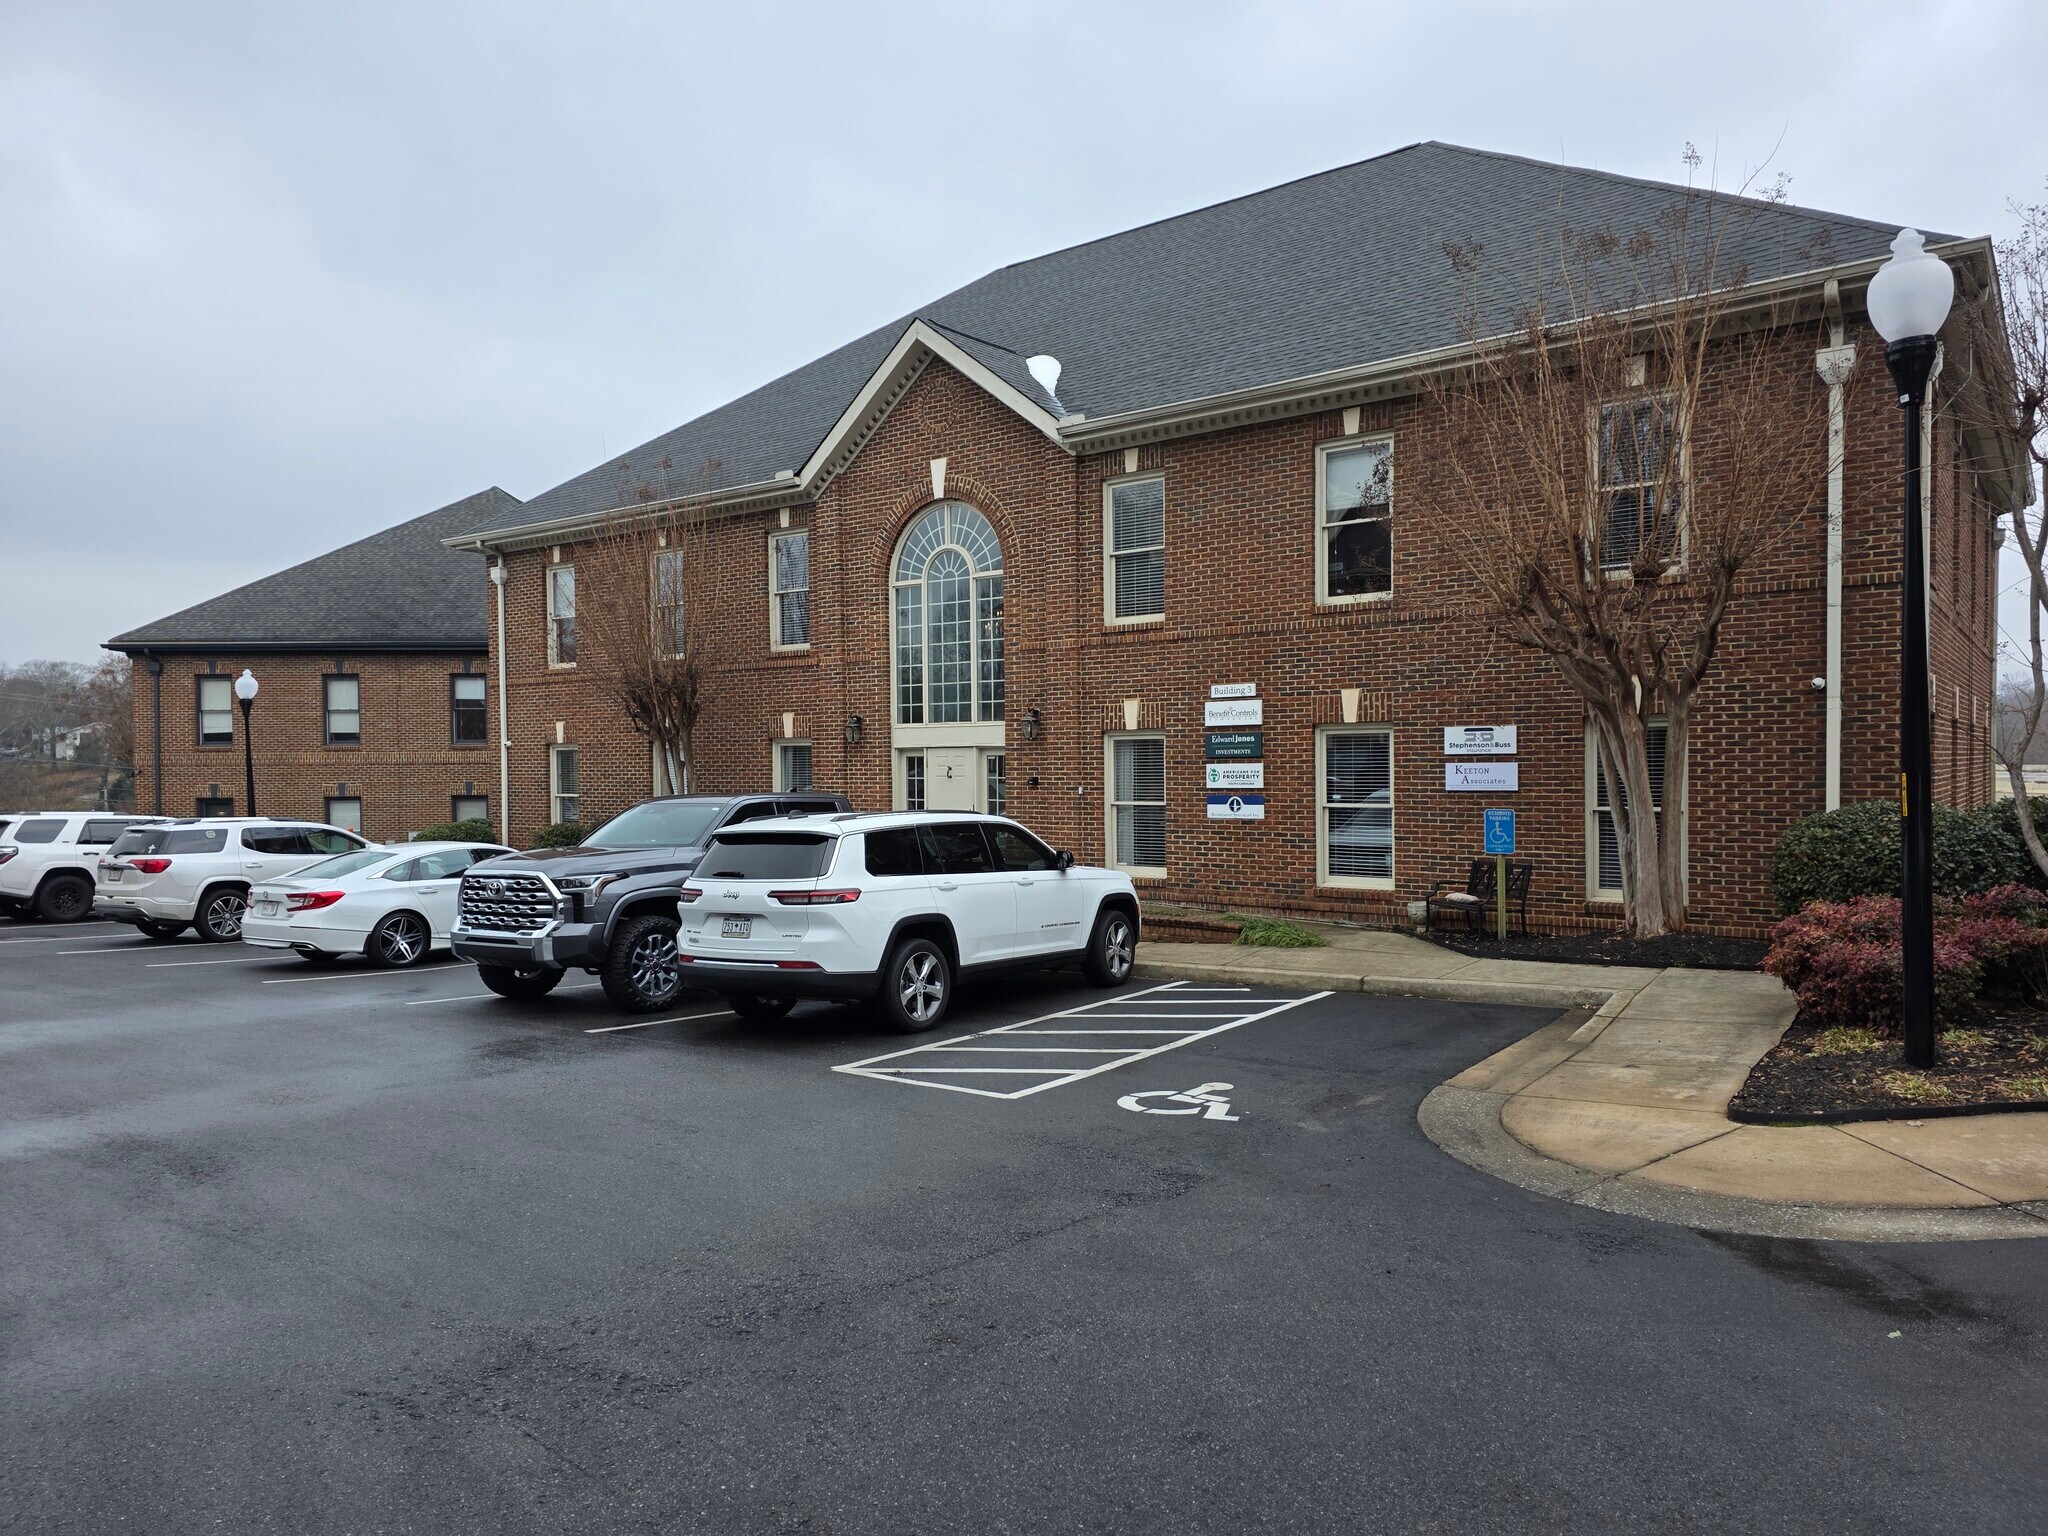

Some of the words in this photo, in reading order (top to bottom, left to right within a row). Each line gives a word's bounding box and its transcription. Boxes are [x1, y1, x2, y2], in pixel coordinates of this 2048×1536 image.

[1214, 686, 1246, 696] Building
[1247, 685, 1252, 694] 3
[1230, 708, 1258, 717] Controls
[1455, 765, 1490, 774] KEETON
[1461, 775, 1507, 784] Associates
[723, 922, 734, 932] 753
